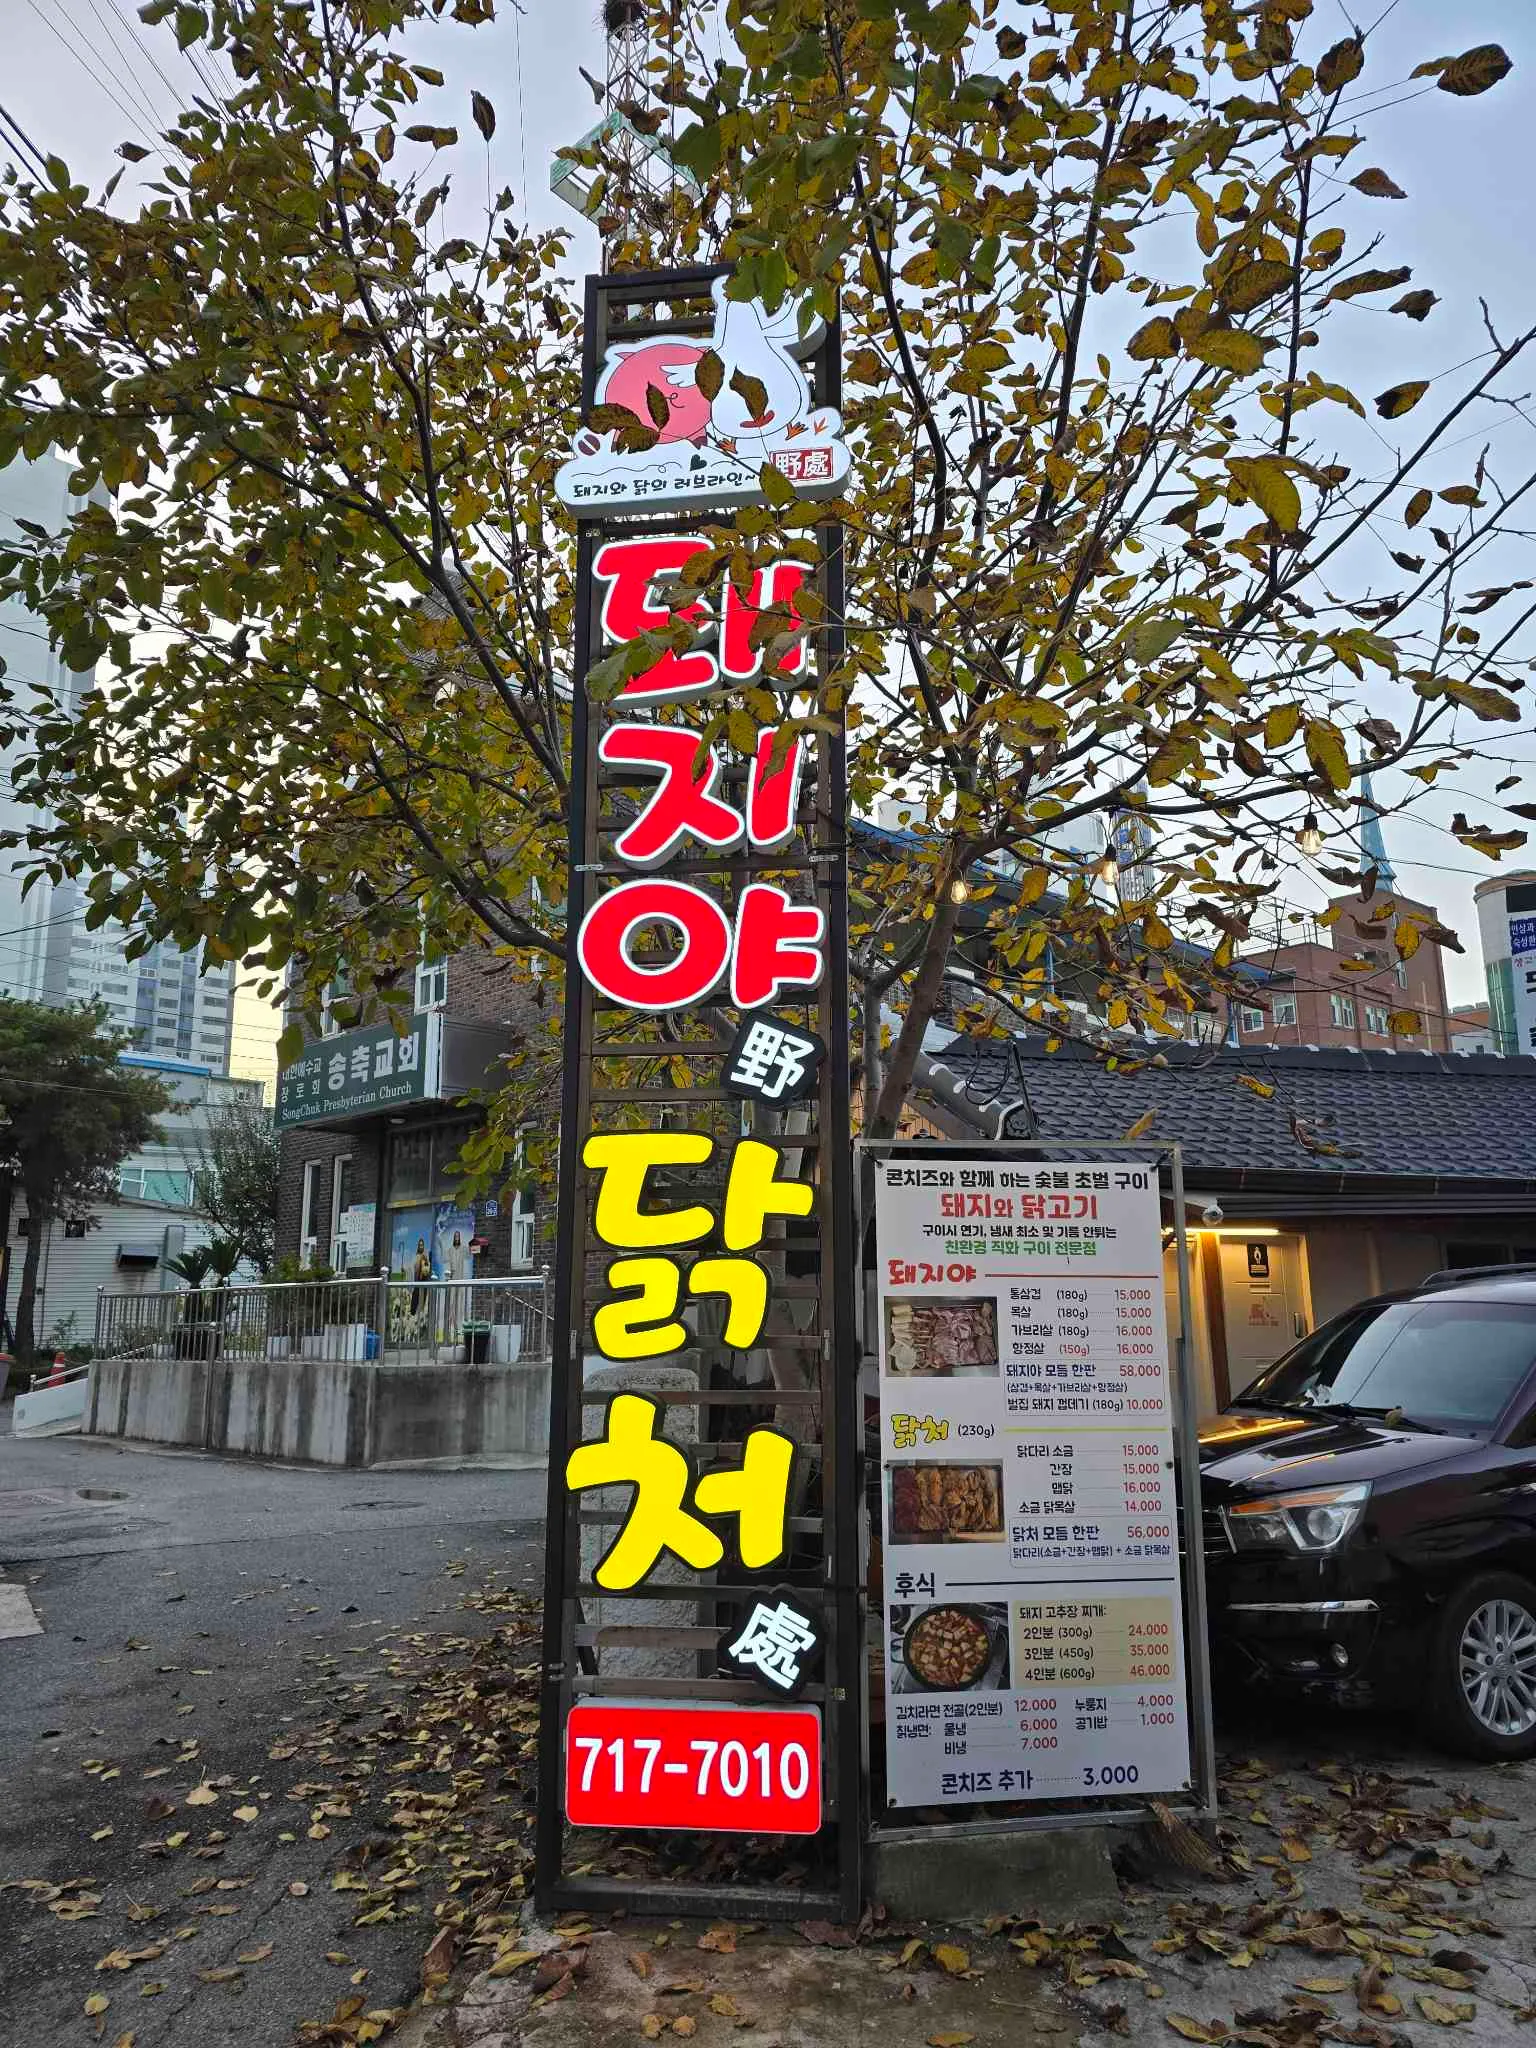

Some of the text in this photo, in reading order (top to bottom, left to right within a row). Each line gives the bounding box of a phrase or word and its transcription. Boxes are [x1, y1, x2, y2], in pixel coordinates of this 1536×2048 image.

[776, 450, 829, 479] 野處
[573, 481, 627, 498] 돼지와
[633, 477, 667, 495] 닭의
[577, 536, 825, 1010] 돼지야
[328, 1032, 419, 1090] 송축교회
[730, 1019, 805, 1098] 野
[282, 1080, 412, 1121] SongChuk Presbyterian Church
[886, 1168, 954, 1187] 콘치즈와
[959, 1169, 995, 1188] 함께
[1000, 1172, 1030, 1188] 하는
[1075, 1171, 1110, 1189] 초벌
[1115, 1172, 1149, 1190] 구이
[941, 1193, 1097, 1220] 돼지와 닭고기
[922, 1224, 957, 1237] 구이시
[960, 1224, 987, 1237] 연기,
[990, 1225, 1013, 1238] 냄새
[1016, 1226, 1039, 1238] 최소
[1057, 1226, 1080, 1238] 기름
[1083, 1226, 1117, 1239] 안튀는
[945, 1240, 1097, 1256] 친환경 직화 구이 전문점
[888, 1260, 977, 1285] 돼지야
[1010, 1288, 1041, 1300] 통삼겹
[1056, 1290, 1088, 1302] (180g)
[1011, 1306, 1032, 1319] 목살
[1057, 1308, 1089, 1320] (180g)
[1012, 1325, 1054, 1337] 가브리살
[1058, 1326, 1090, 1338] (180g)
[1012, 1342, 1045, 1355] 항정살
[1060, 1344, 1090, 1357] (150g)
[566, 1132, 814, 1590] 닭처
[1006, 1364, 1042, 1378] 돼지야
[1045, 1365, 1069, 1378] 모듬
[1072, 1365, 1097, 1378] 한판
[1007, 1398, 1029, 1411] 벌집
[1032, 1399, 1054, 1411] 돼지
[1057, 1399, 1089, 1411] 껍데기
[1092, 1400, 1123, 1412] (180g)
[891, 1414, 995, 1449] 닭처 (230g)
[1016, 1445, 1050, 1458] 닭다리
[1052, 1445, 1074, 1457] 소금
[1050, 1463, 1073, 1476] 간장
[1019, 1501, 1041, 1513] 소금
[1043, 1500, 1076, 1514] 닭목살
[1012, 1526, 1039, 1543] 닭처
[1042, 1525, 1069, 1541] 모듬
[1072, 1525, 1100, 1541] 한판
[1124, 1546, 1142, 1556] 소금
[895, 1573, 935, 1597] 후식
[1019, 1606, 1043, 1619] 돼지
[1046, 1605, 1078, 1618] 고추장
[1023, 1626, 1055, 1640] 2인분
[1058, 1626, 1093, 1640] (300g)
[728, 1602, 817, 1690] 處
[1024, 1647, 1055, 1660] 3인분
[1059, 1646, 1094, 1661] (450g)
[1025, 1668, 1056, 1681] 4인분
[1060, 1667, 1095, 1681] (600g)
[895, 1704, 941, 1719] 김치라면
[943, 1701, 1003, 1717] 전골(2인분)
[1074, 1697, 1107, 1712] 누룽지
[943, 1722, 967, 1737] 물냉
[1074, 1716, 1108, 1730] 공기밥
[943, 1741, 967, 1755] 비냉
[576, 1736, 811, 1800] 717-7010
[941, 1765, 1139, 1795] 콘치즈 추가 3,000
